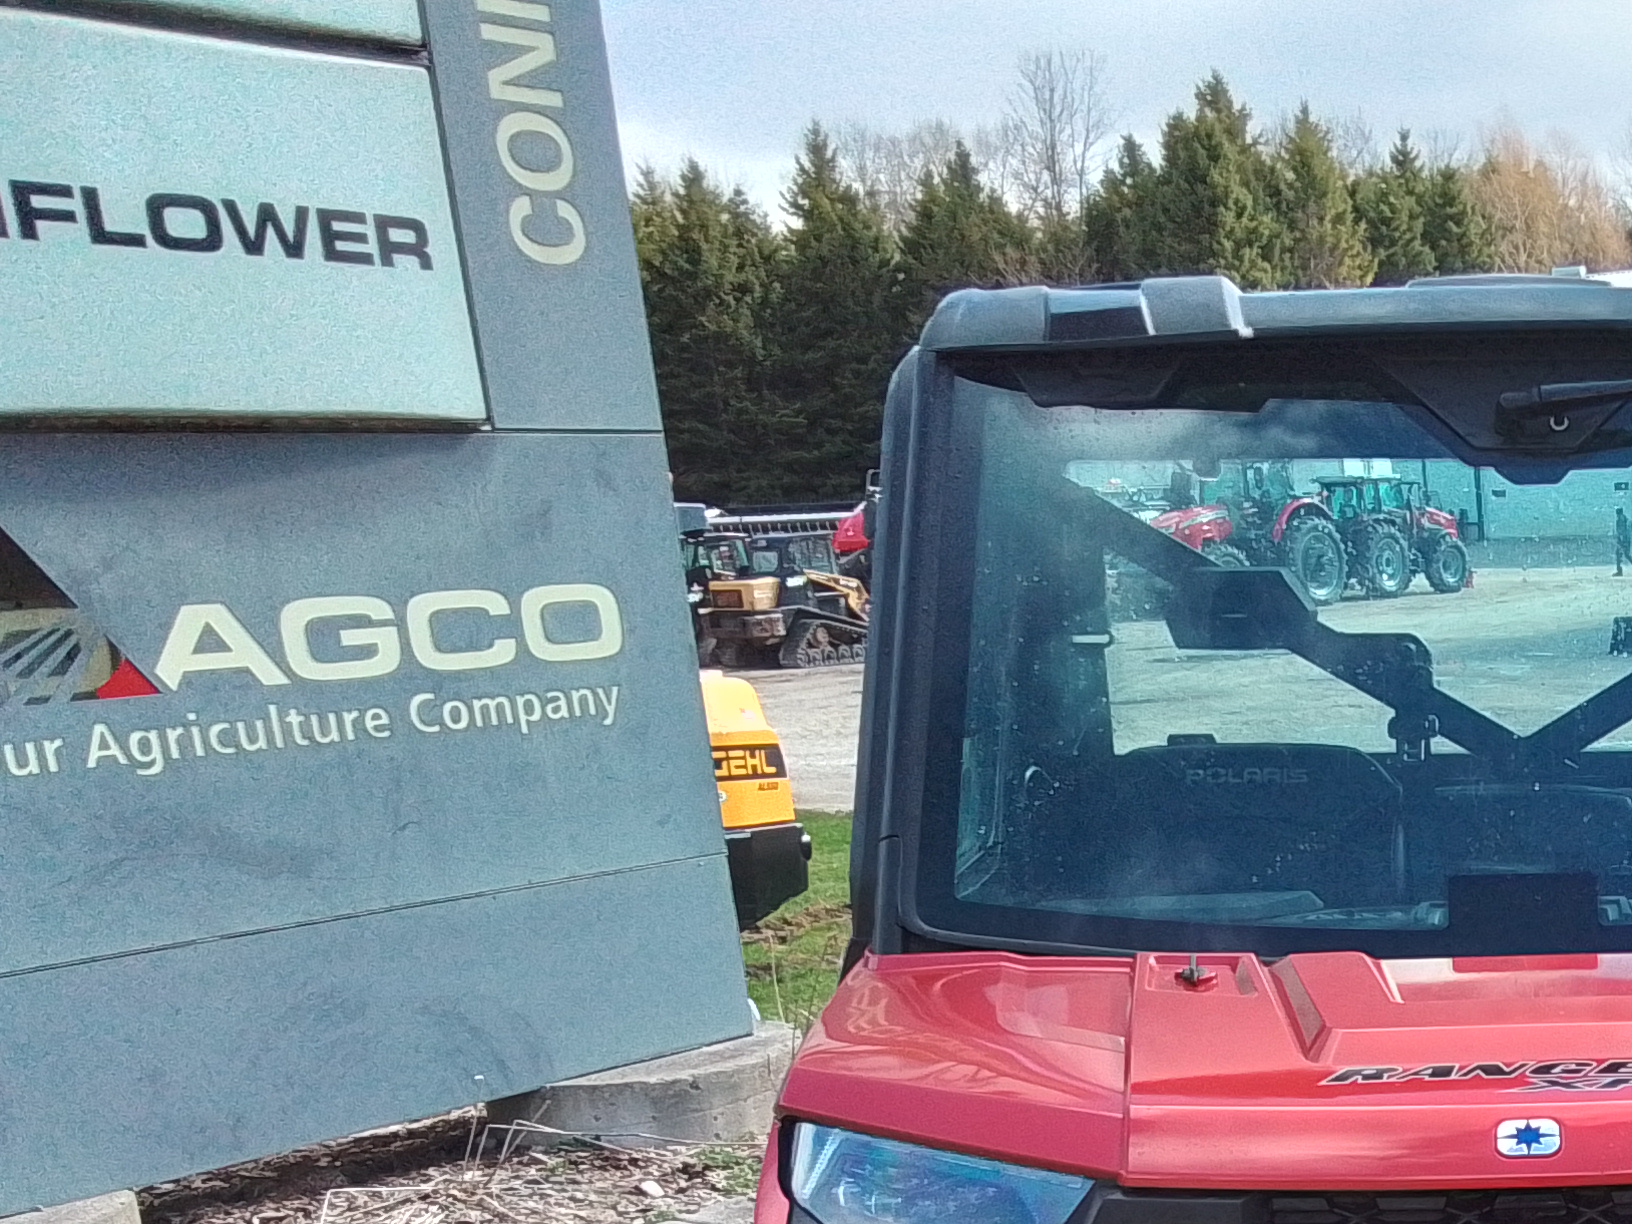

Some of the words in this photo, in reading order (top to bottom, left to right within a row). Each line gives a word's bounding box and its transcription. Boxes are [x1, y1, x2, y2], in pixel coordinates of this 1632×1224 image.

[0, 179, 433, 271] FLOWER
[154, 583, 624, 692] AGCO
[86, 704, 392, 776] Agriculture
[410, 686, 619, 734] Company
[1186, 767, 1308, 785] POLARIS
